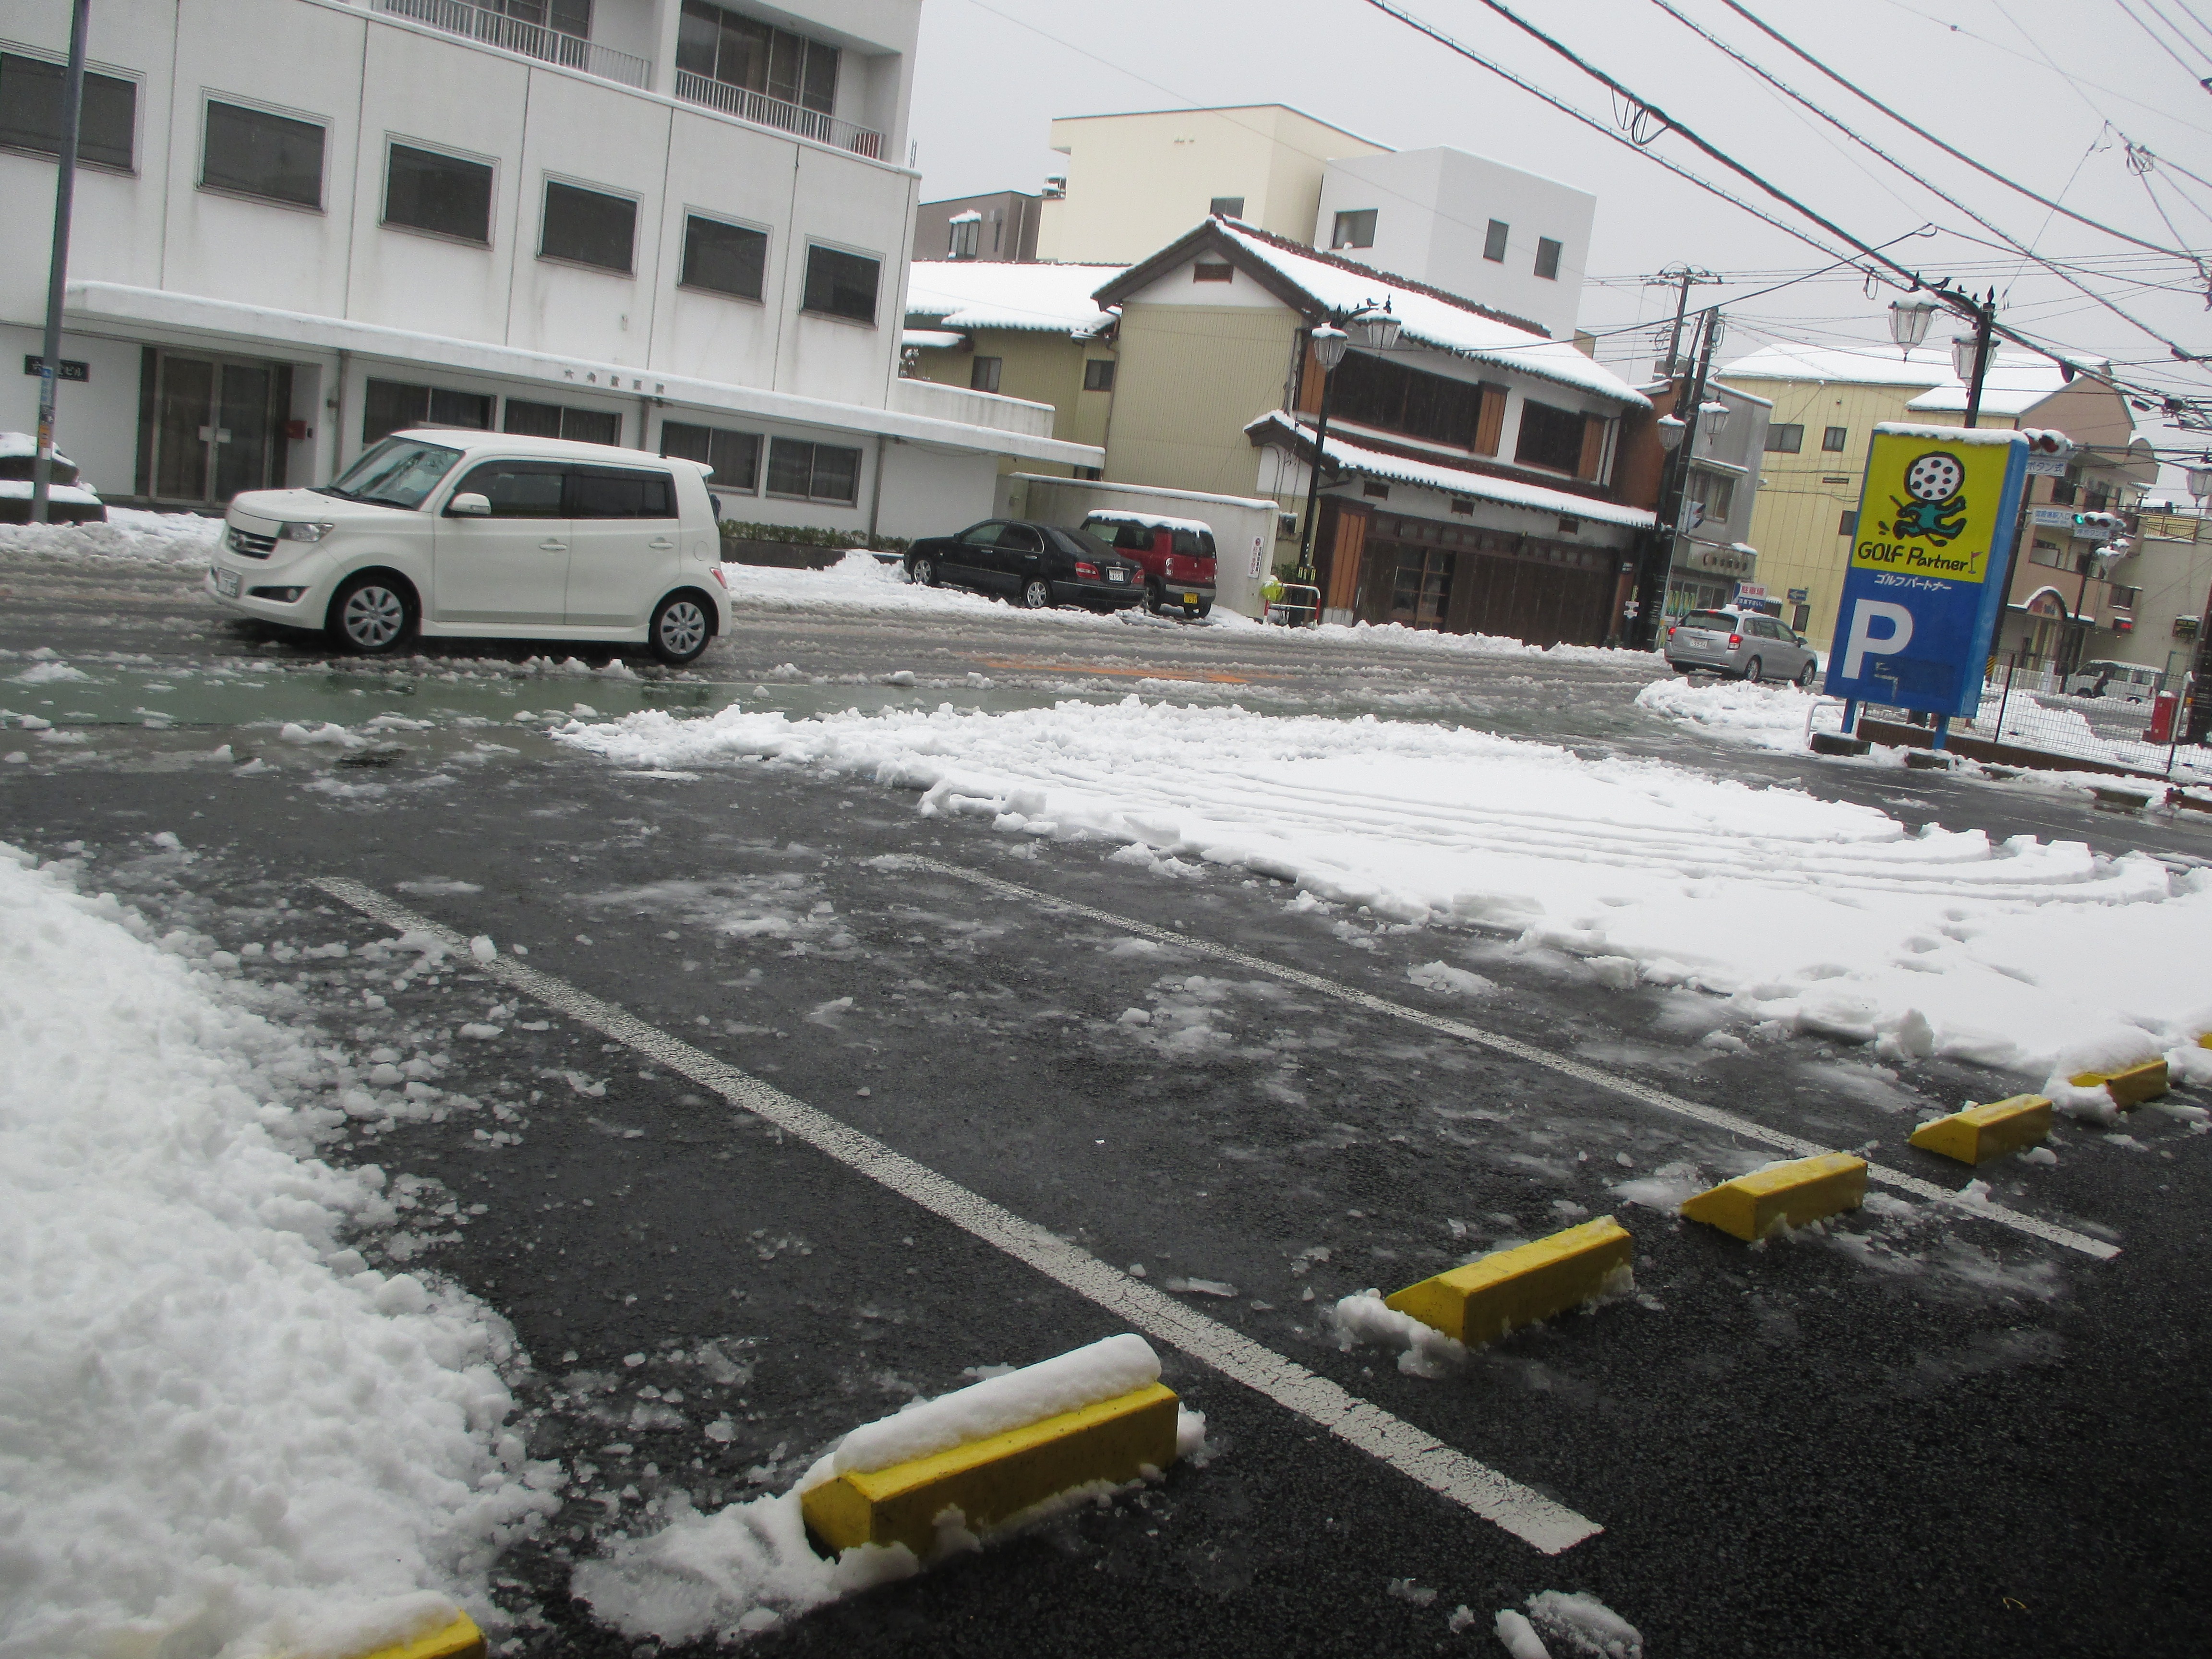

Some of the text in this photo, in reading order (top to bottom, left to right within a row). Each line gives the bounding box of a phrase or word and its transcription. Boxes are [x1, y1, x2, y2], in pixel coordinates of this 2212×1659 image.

[1906, 546, 1968, 571] Partner
[1874, 573, 1952, 591] ゴルフパートナー
[1841, 598, 1914, 680] P
